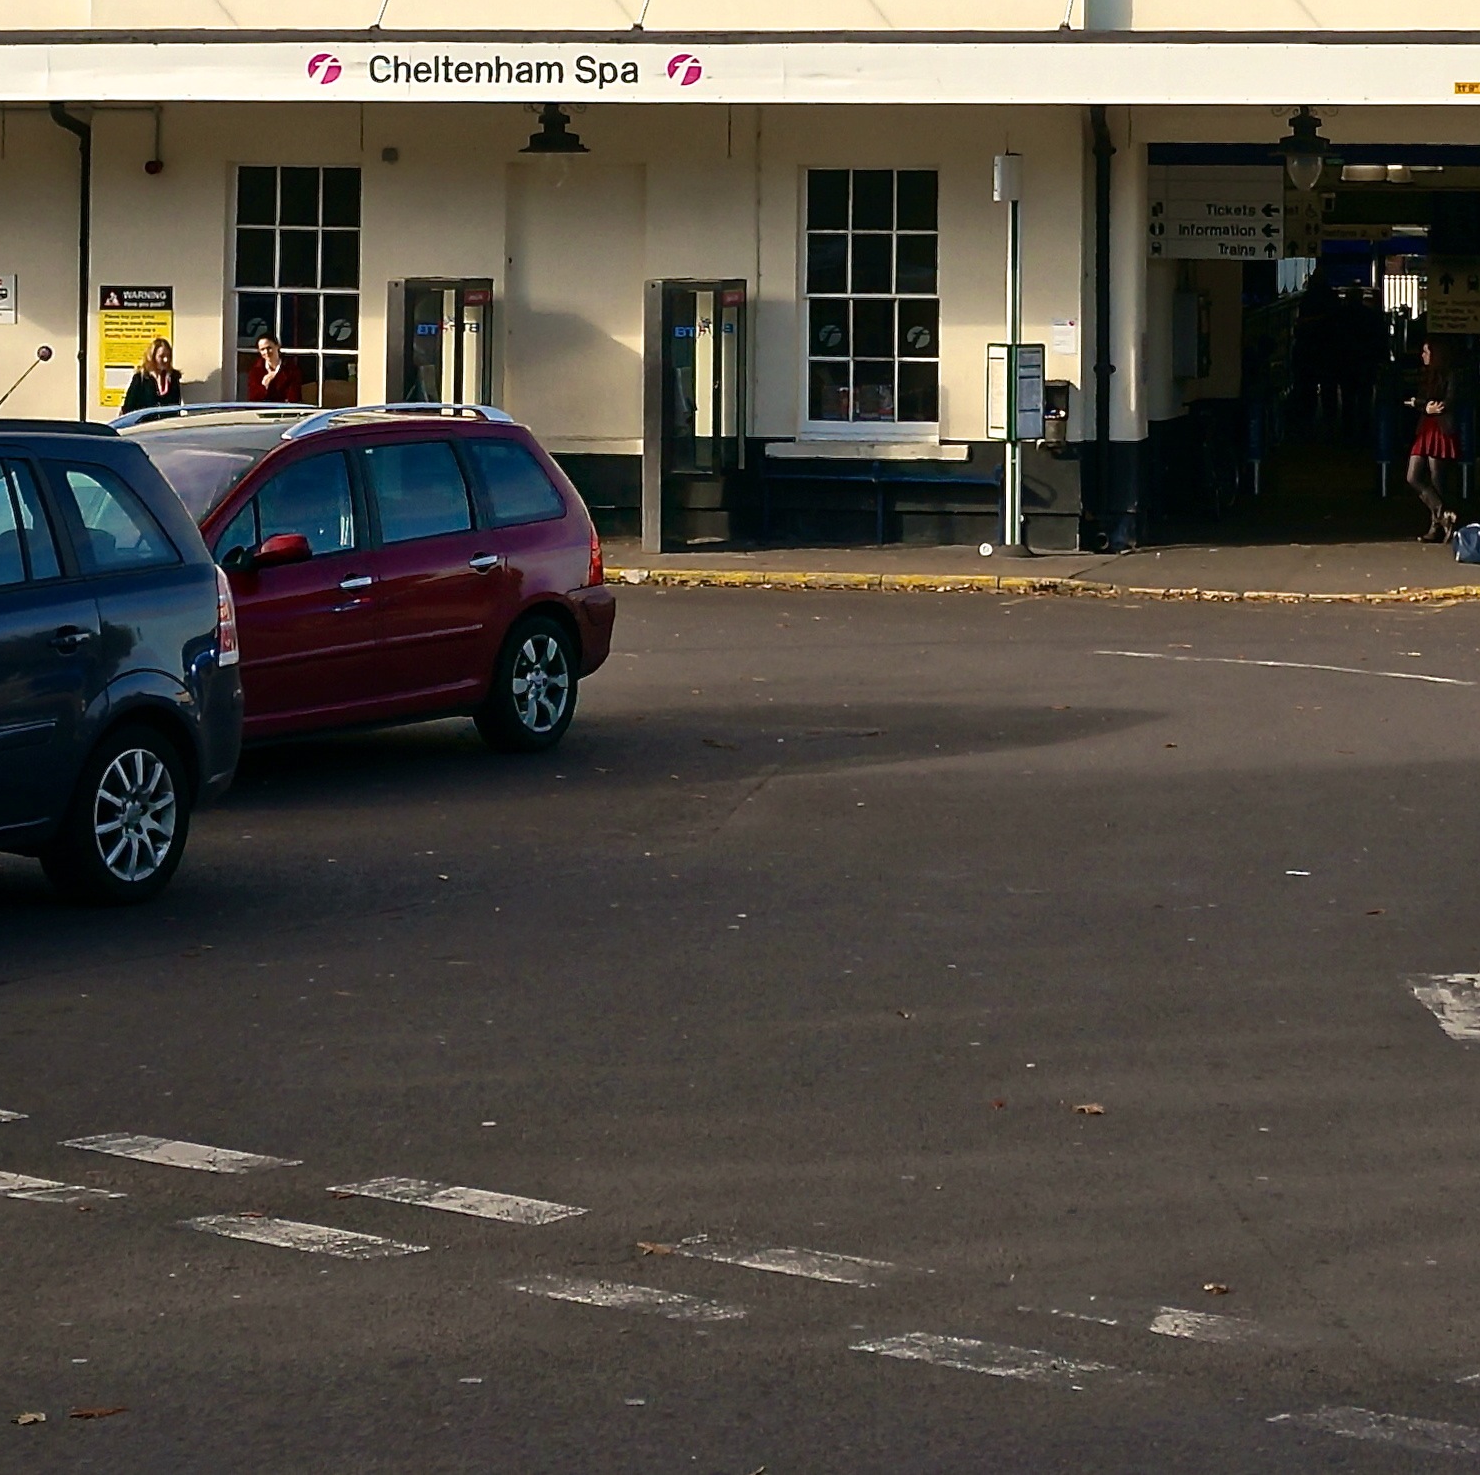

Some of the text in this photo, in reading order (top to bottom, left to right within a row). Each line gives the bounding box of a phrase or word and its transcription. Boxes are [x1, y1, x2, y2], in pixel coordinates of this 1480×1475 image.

[369, 55, 639, 89] Cheltenham Spa
[1206, 203, 1256, 216] Tickets
[1178, 225, 1256, 237] Information
[1218, 243, 1256, 257] Trains
[123, 291, 167, 300] WARNING
[416, 324, 438, 336] BT
[675, 326, 695, 338] BT
